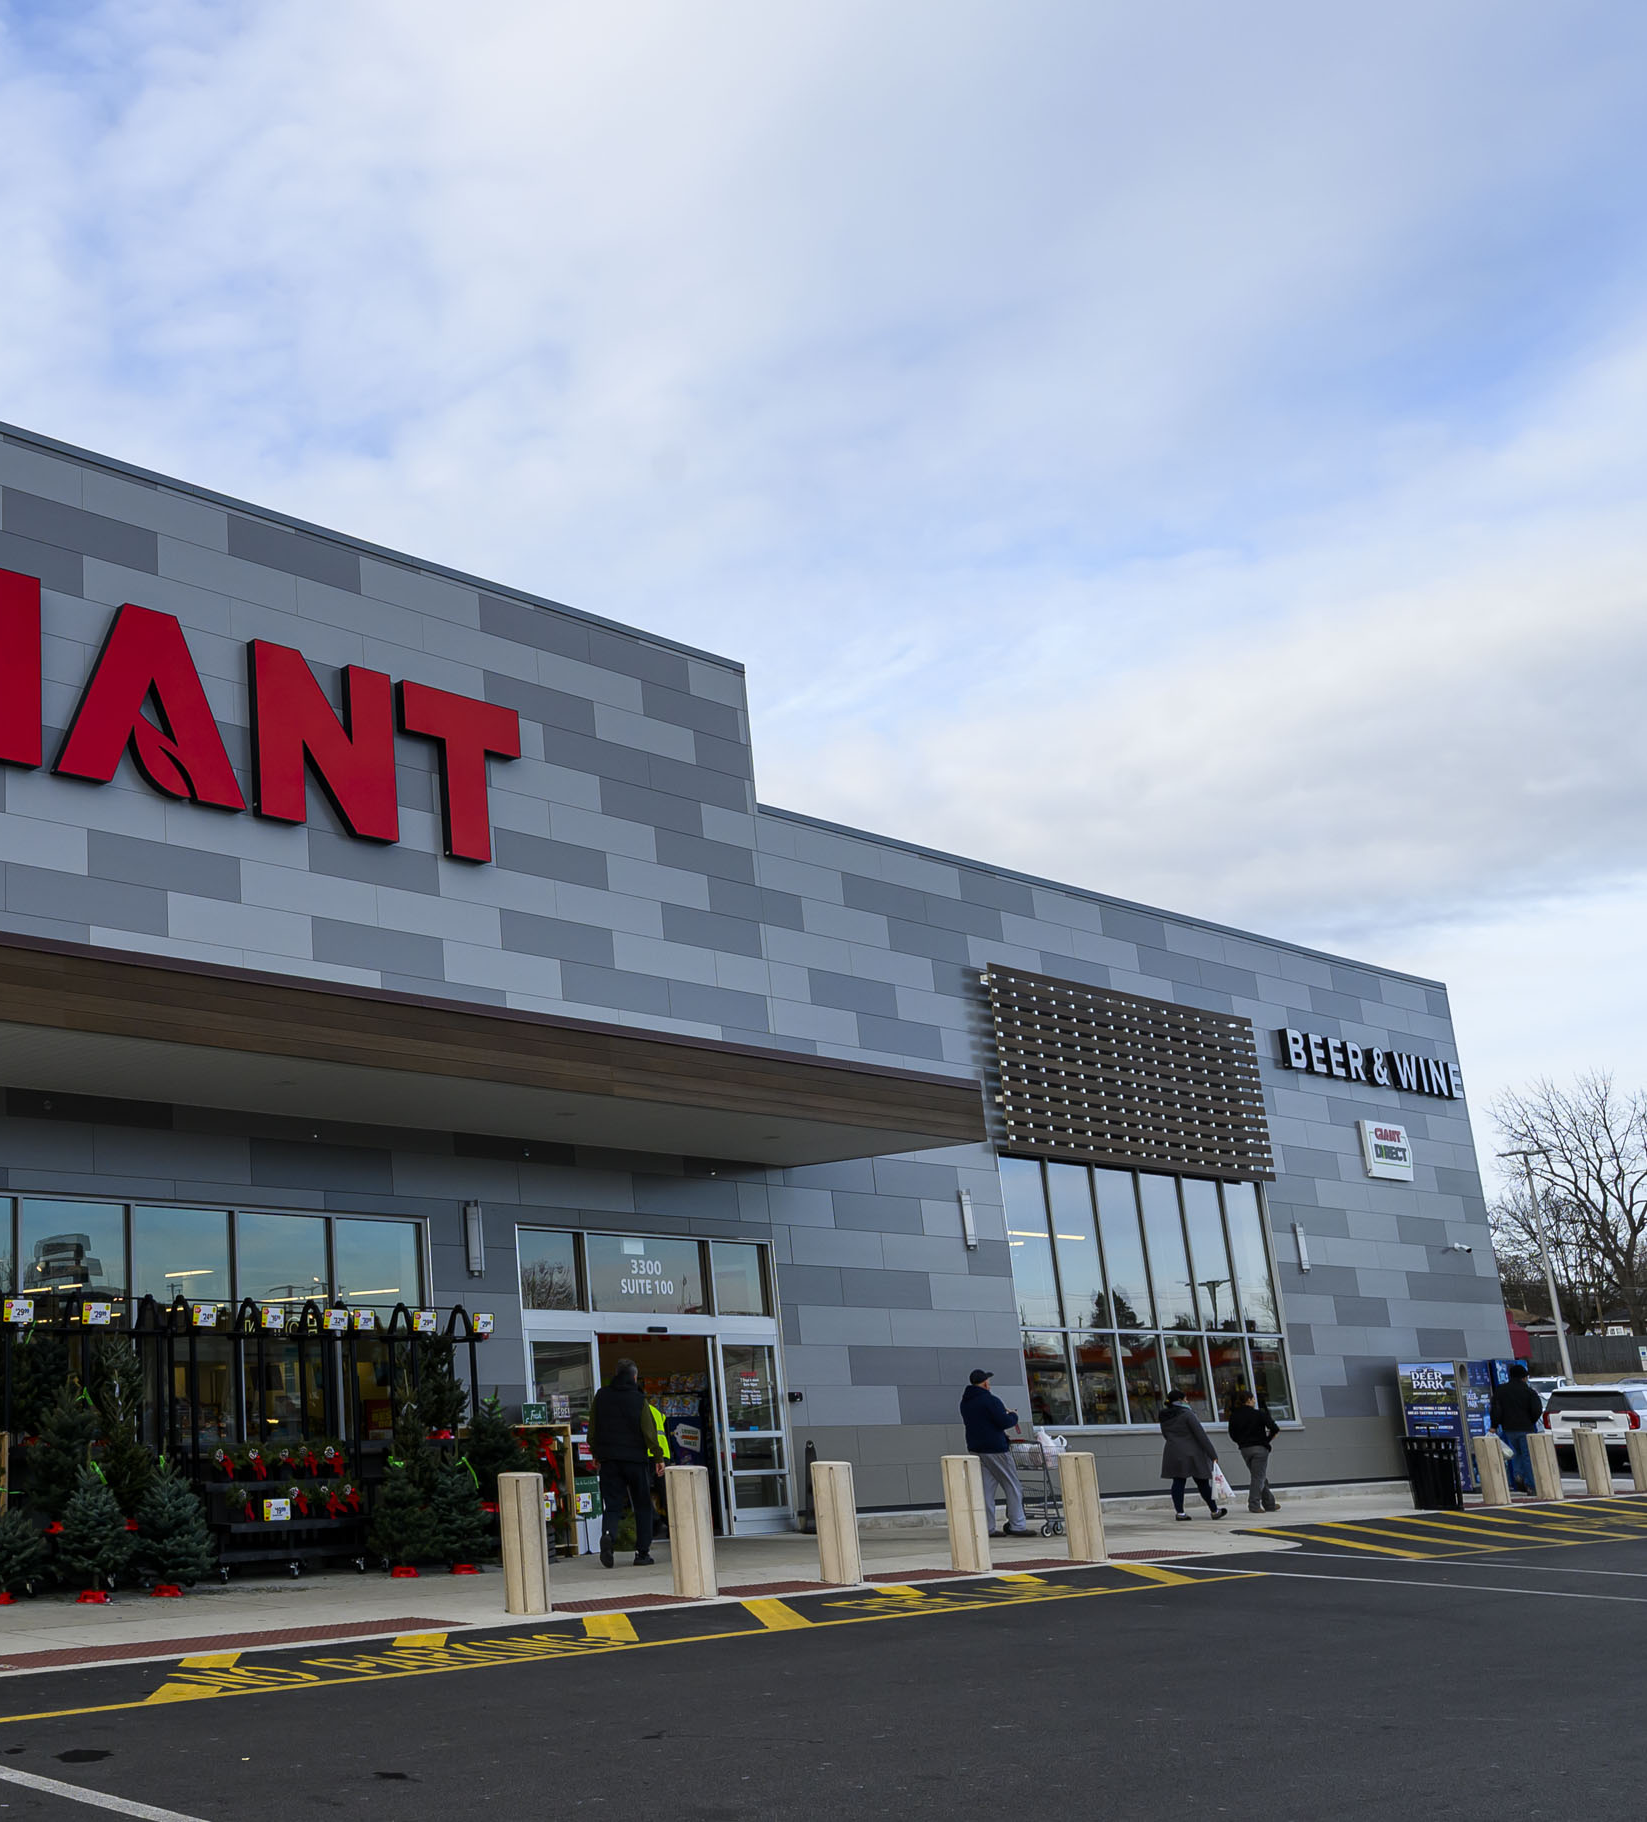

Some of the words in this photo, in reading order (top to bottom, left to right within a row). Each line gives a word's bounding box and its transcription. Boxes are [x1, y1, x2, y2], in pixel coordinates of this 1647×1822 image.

[1283, 1028, 1366, 1081] BEER
[1372, 1047, 1391, 1086] &
[1391, 1051, 1465, 1099] WINE
[1374, 1127, 1402, 1143] GIANT
[1374, 1143, 1408, 1162] DIRECT
[630, 1259, 662, 1276] 3300
[620, 1278, 653, 1295] SUITE
[654, 1280, 674, 1295] 100
[1411, 1371, 1442, 1380] DEER
[1412, 1381, 1444, 1390] PARK
[167, 1665, 321, 1689] NO
[299, 1633, 626, 1675] PARKING
